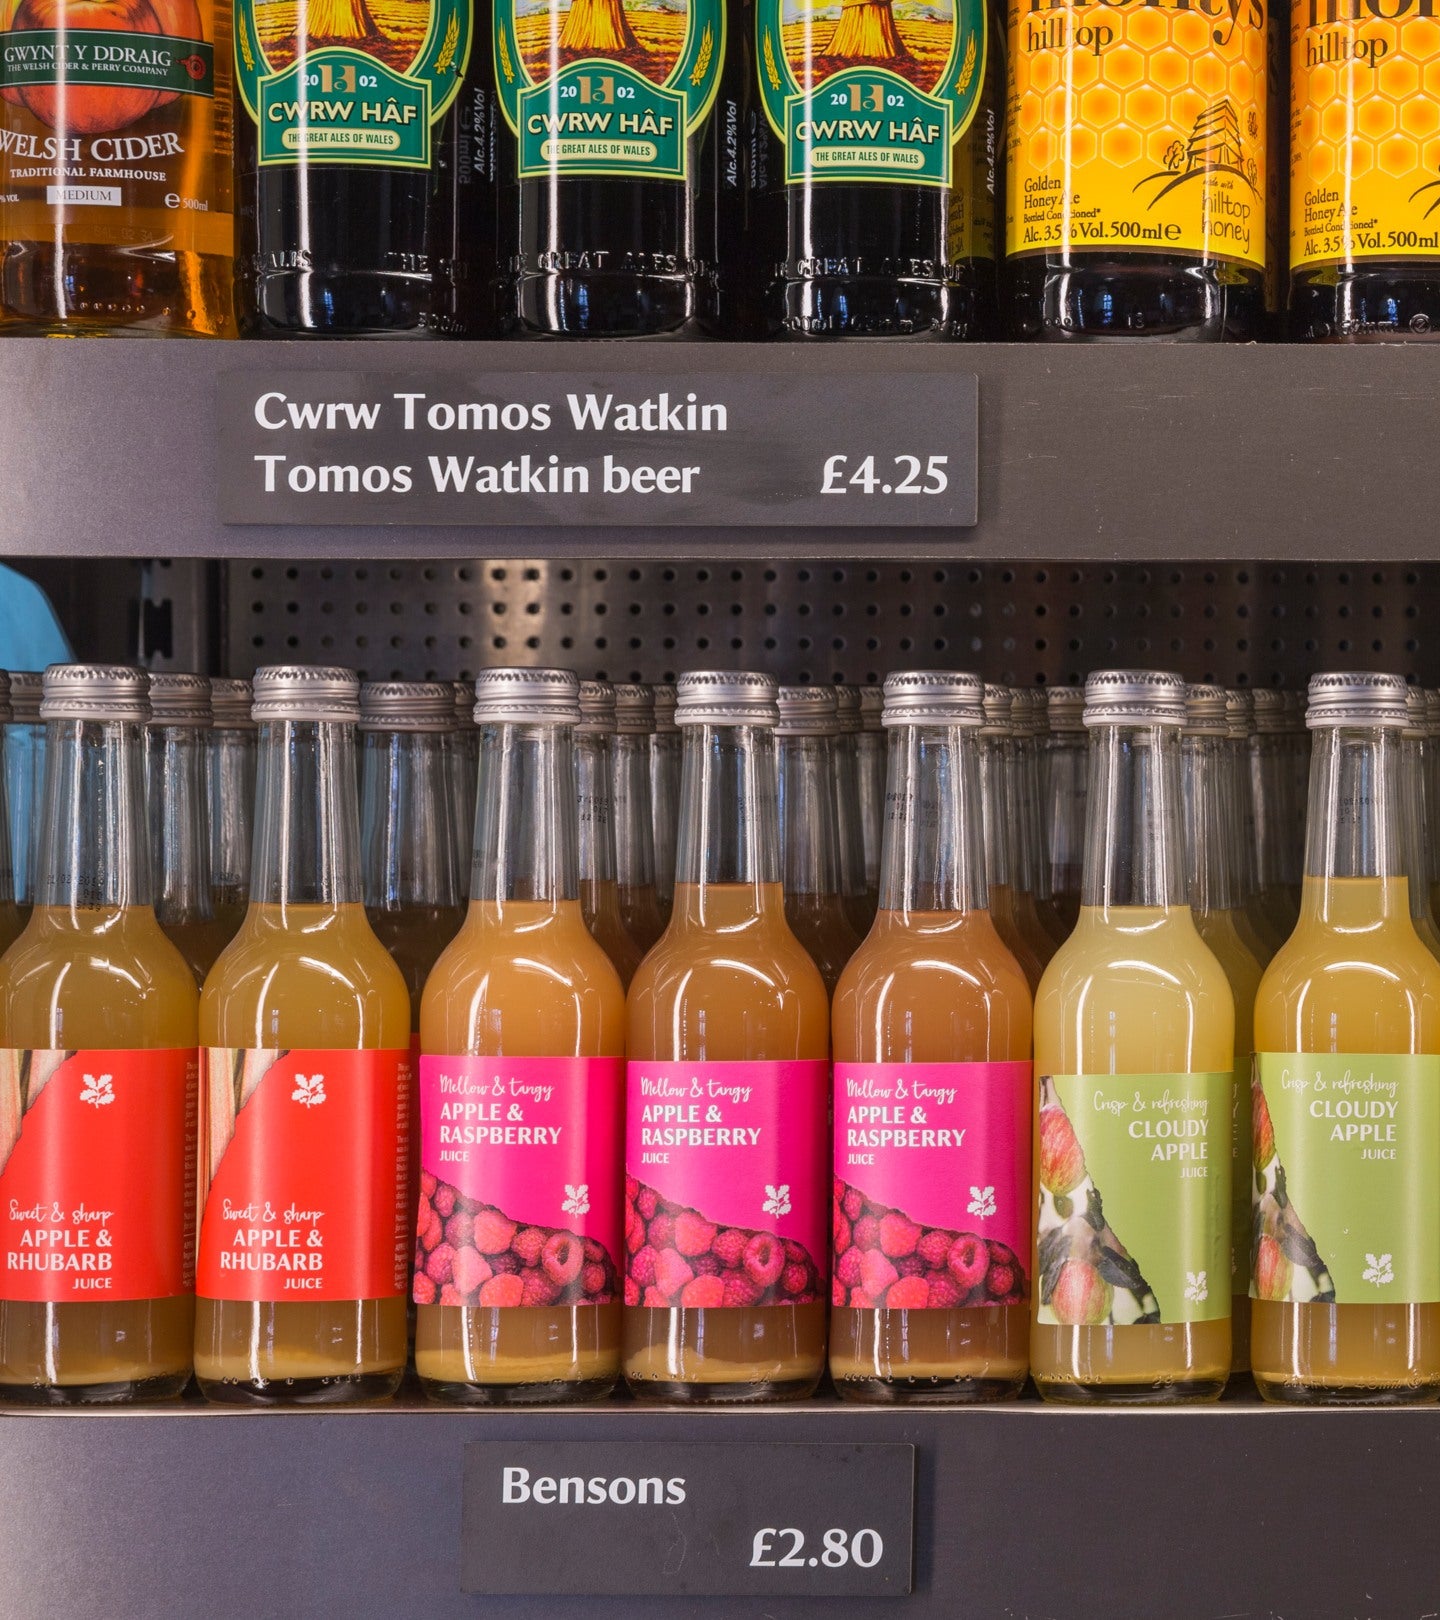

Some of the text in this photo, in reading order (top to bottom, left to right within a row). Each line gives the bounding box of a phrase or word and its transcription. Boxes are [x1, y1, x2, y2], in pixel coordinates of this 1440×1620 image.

[4, 45, 171, 67] GWYNT Y DDRAIG
[1306, 32, 1388, 68] hilltop
[8, 64, 21, 72] THE
[23, 63, 49, 71] WELSH
[52, 62, 79, 70] CIDER
[92, 63, 120, 72] PERRY
[122, 65, 168, 76] COMPANY
[268, 96, 418, 124] CWRW HÂF
[527, 108, 674, 136] CWRW HÂF
[795, 116, 940, 144] CWRW HÂF
[0, 129, 184, 162] WELSH CIDER
[304, 132, 328, 142] GREAT
[330, 132, 350, 142] ALES
[352, 132, 363, 143] OF
[365, 133, 394, 145] WALES
[562, 144, 586, 154] GREAT
[588, 144, 608, 154] ALES
[610, 144, 621, 155] OF
[623, 145, 650, 156] WALES
[10, 168, 166, 181] TRADITIONAL FARMHOUSE
[57, 189, 111, 201] MEDIUM
[1024, 178, 1061, 193] Golden
[254, 391, 727, 431] Cwrw Tomos Watkin
[254, 453, 949, 495] Tomos Watkin beer £4.25
[440, 1074, 555, 1102] Mellow & tangy
[440, 1102, 524, 1121] APPLE &
[1309, 1100, 1399, 1119] CLOUDY
[440, 1126, 562, 1145] RASPBERRY
[641, 1127, 761, 1146] RASPBERRY
[847, 1129, 966, 1148] RASPBERRY
[1128, 1120, 1209, 1139] CLOUDY
[1330, 1124, 1397, 1142] APPLE
[439, 1151, 469, 1162] JUICE
[1151, 1142, 1208, 1161] APPLE
[9, 1199, 114, 1231] Sweet & sharp
[20, 1229, 113, 1248] APPLE &
[234, 1229, 323, 1248] APPLE &
[7, 1252, 112, 1271] RHUBARB
[220, 1252, 323, 1271] RHUBARB
[72, 1277, 112, 1290] JUICE
[284, 1277, 323, 1290] JUICE
[502, 1467, 686, 1505] Bensons
[749, 1528, 883, 1568] £2.80
